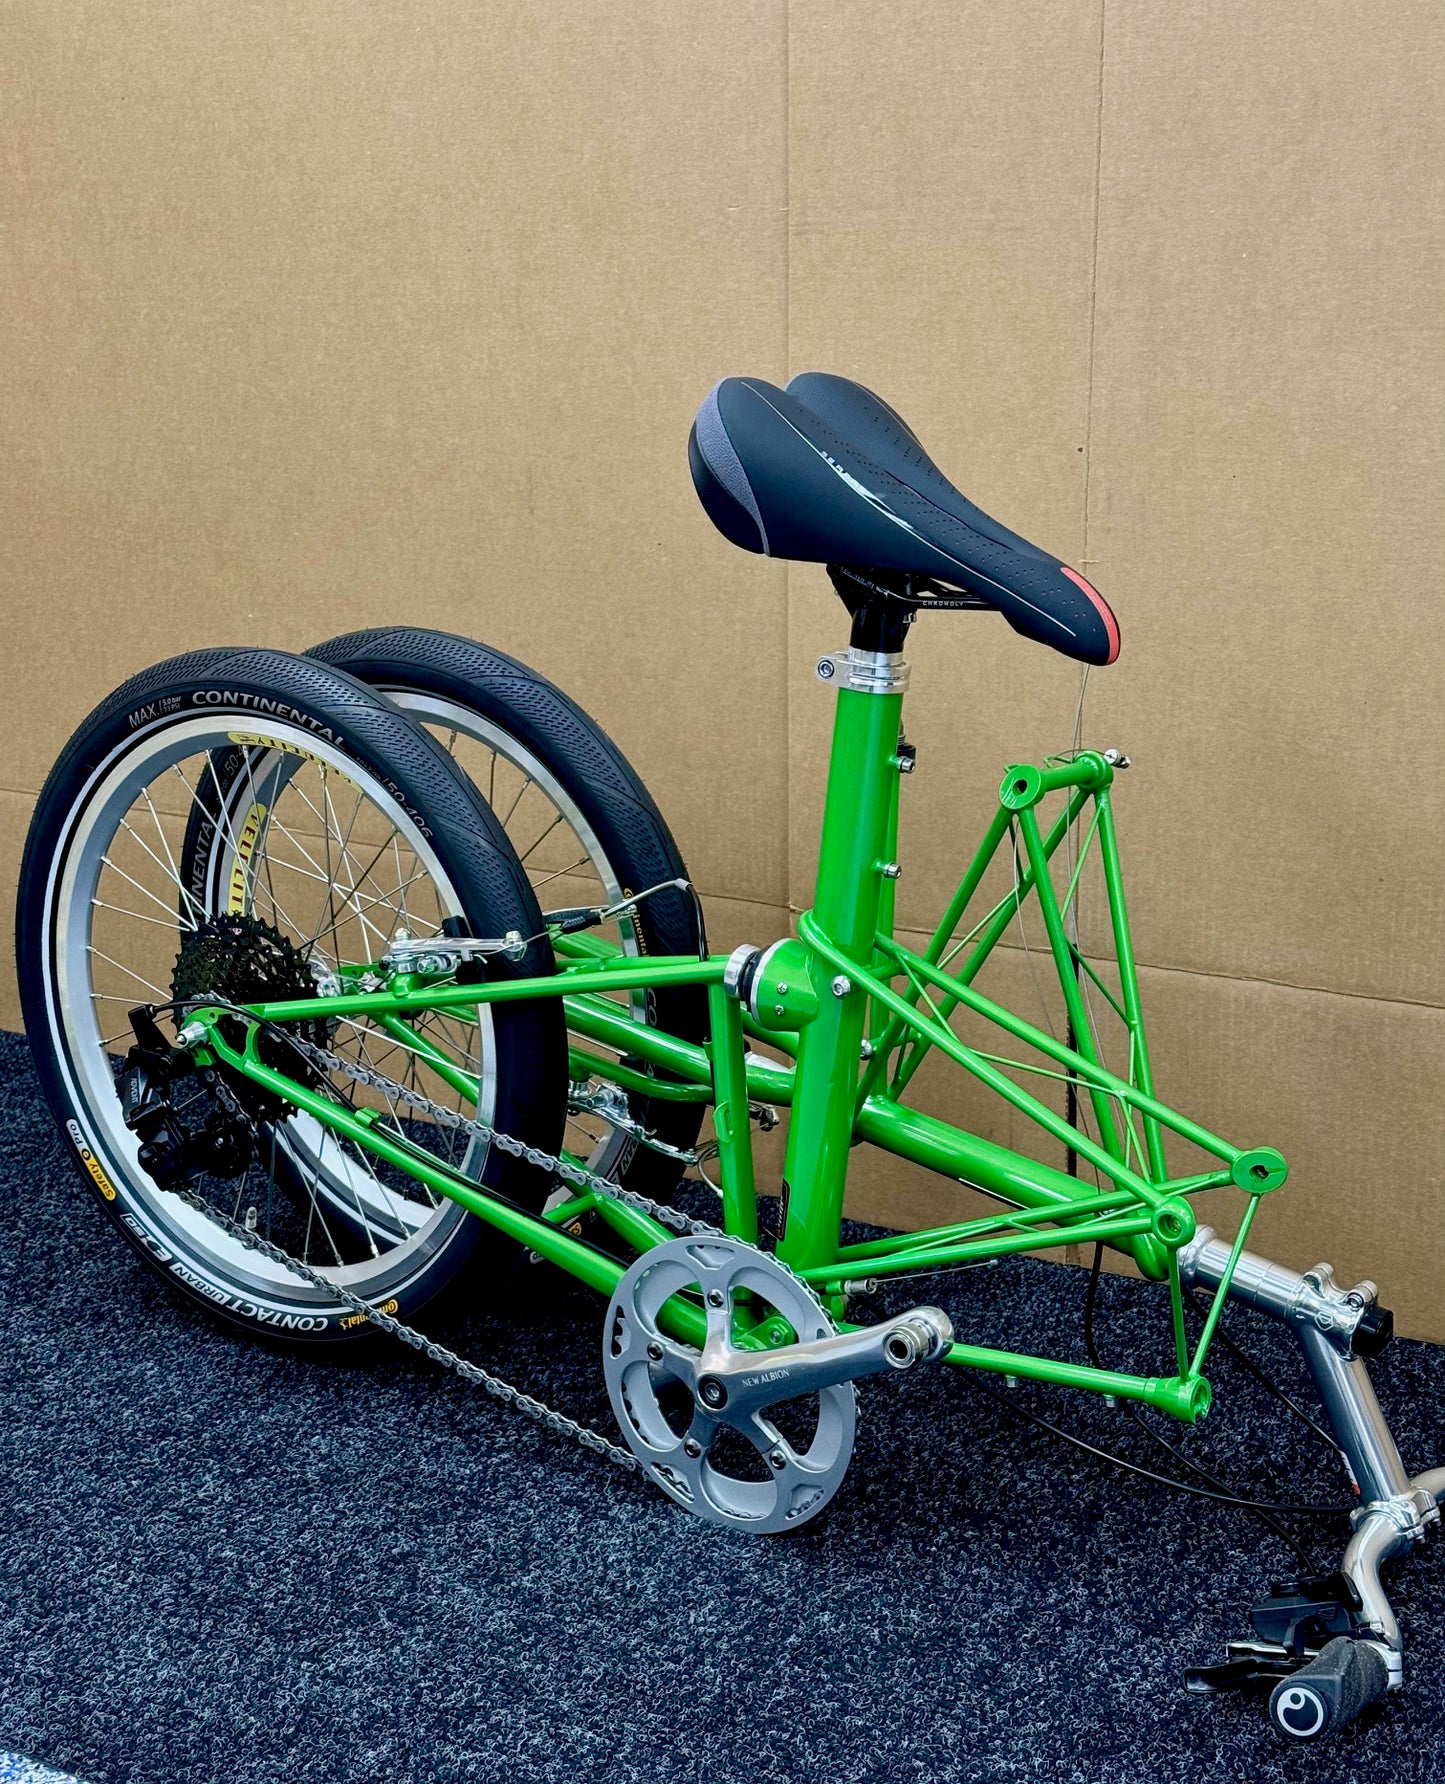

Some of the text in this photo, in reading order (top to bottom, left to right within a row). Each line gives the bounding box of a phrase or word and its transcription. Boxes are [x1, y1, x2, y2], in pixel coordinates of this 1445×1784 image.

[128, 704, 160, 729] MAX.
[192, 690, 347, 750] CONTINENTAL
[386, 782, 434, 838] 50-406
[69, 1122, 114, 1198] Safety Pro
[173, 1265, 232, 1303] URBAN
[223, 1300, 328, 1331] CONTACT
[742, 1368, 790, 1388] NEW ALBION
